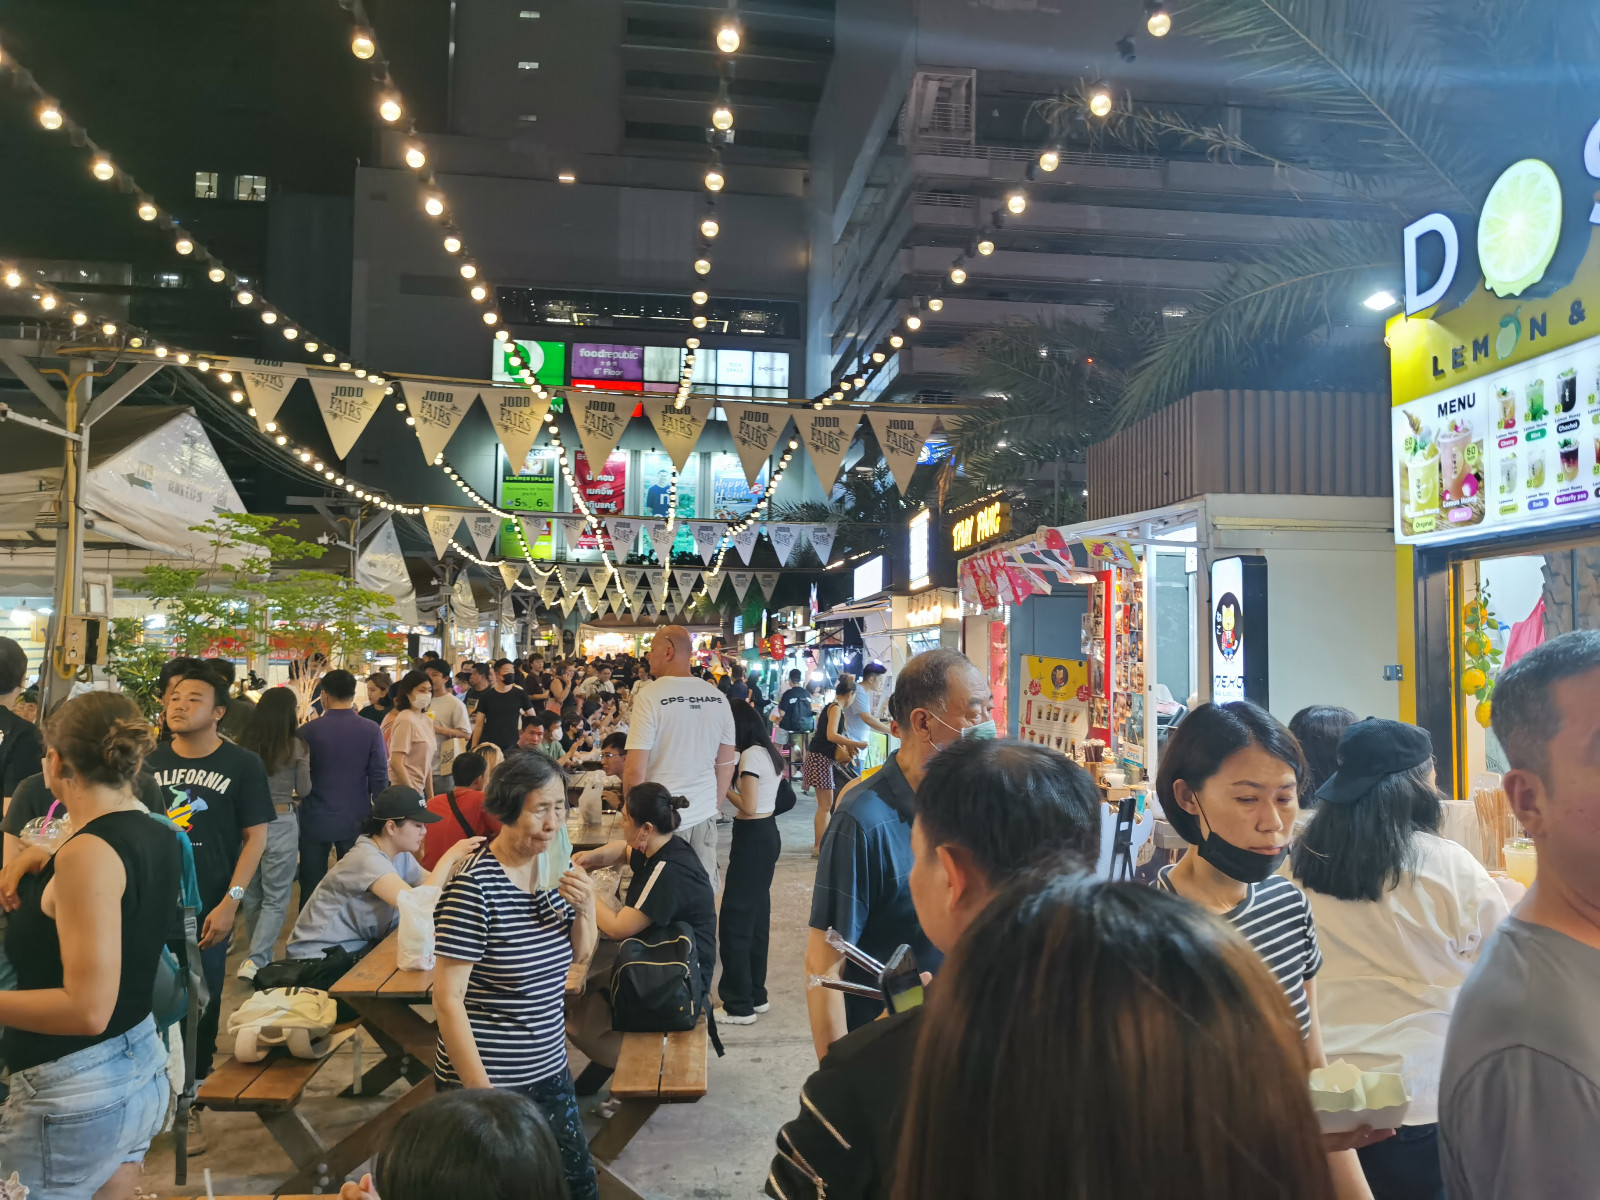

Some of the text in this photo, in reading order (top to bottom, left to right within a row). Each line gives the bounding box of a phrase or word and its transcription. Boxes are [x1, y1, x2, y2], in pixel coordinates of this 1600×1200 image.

[1568, 300, 1586, 326] &
[579, 348, 639, 360] foodrepublic
[603, 368, 623, 376] Floor
[331, 386, 363, 397] JODD
[422, 391, 453, 402] JODD
[500, 396, 530, 407] JODD
[585, 400, 615, 412] JODD
[1437, 392, 1476, 418] MENU
[330, 396, 362, 420] FAIRS
[420, 401, 451, 425] FAIRS
[500, 407, 531, 431] FAIRS
[740, 410, 769, 423] JODD
[811, 417, 839, 427] JODD
[584, 410, 614, 436] FAIRS
[661, 414, 692, 436] FAIRS
[886, 419, 914, 430] JODD
[739, 421, 768, 447] FAIRS
[811, 427, 840, 451] FAIRS
[886, 429, 915, 454] FAIRS
[1404, 437, 1413, 446] 60
[1466, 446, 1476, 455] 60
[1442, 500, 1460, 508] Lemon
[1127, 751, 1139, 760] OPEN
[154, 769, 231, 794] ALIFORNIA
